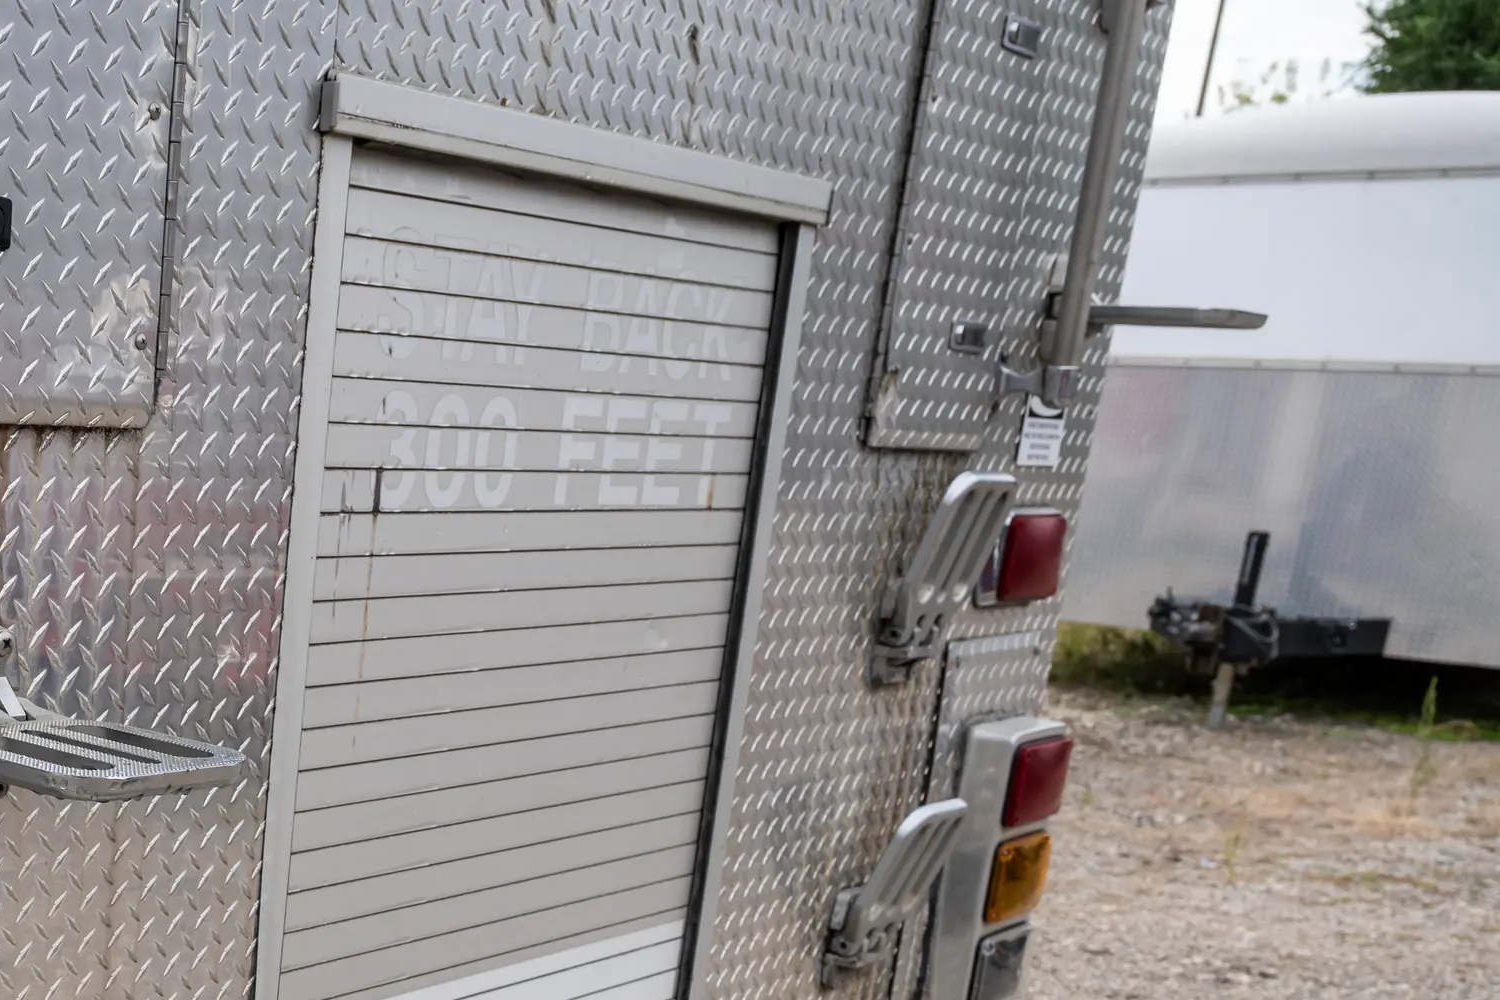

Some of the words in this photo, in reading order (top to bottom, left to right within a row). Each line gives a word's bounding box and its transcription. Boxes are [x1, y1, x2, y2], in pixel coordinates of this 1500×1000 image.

[378, 225, 551, 366] STAY
[578, 257, 742, 382] BACK
[372, 389, 518, 510] 300
[554, 395, 733, 507] FEET
